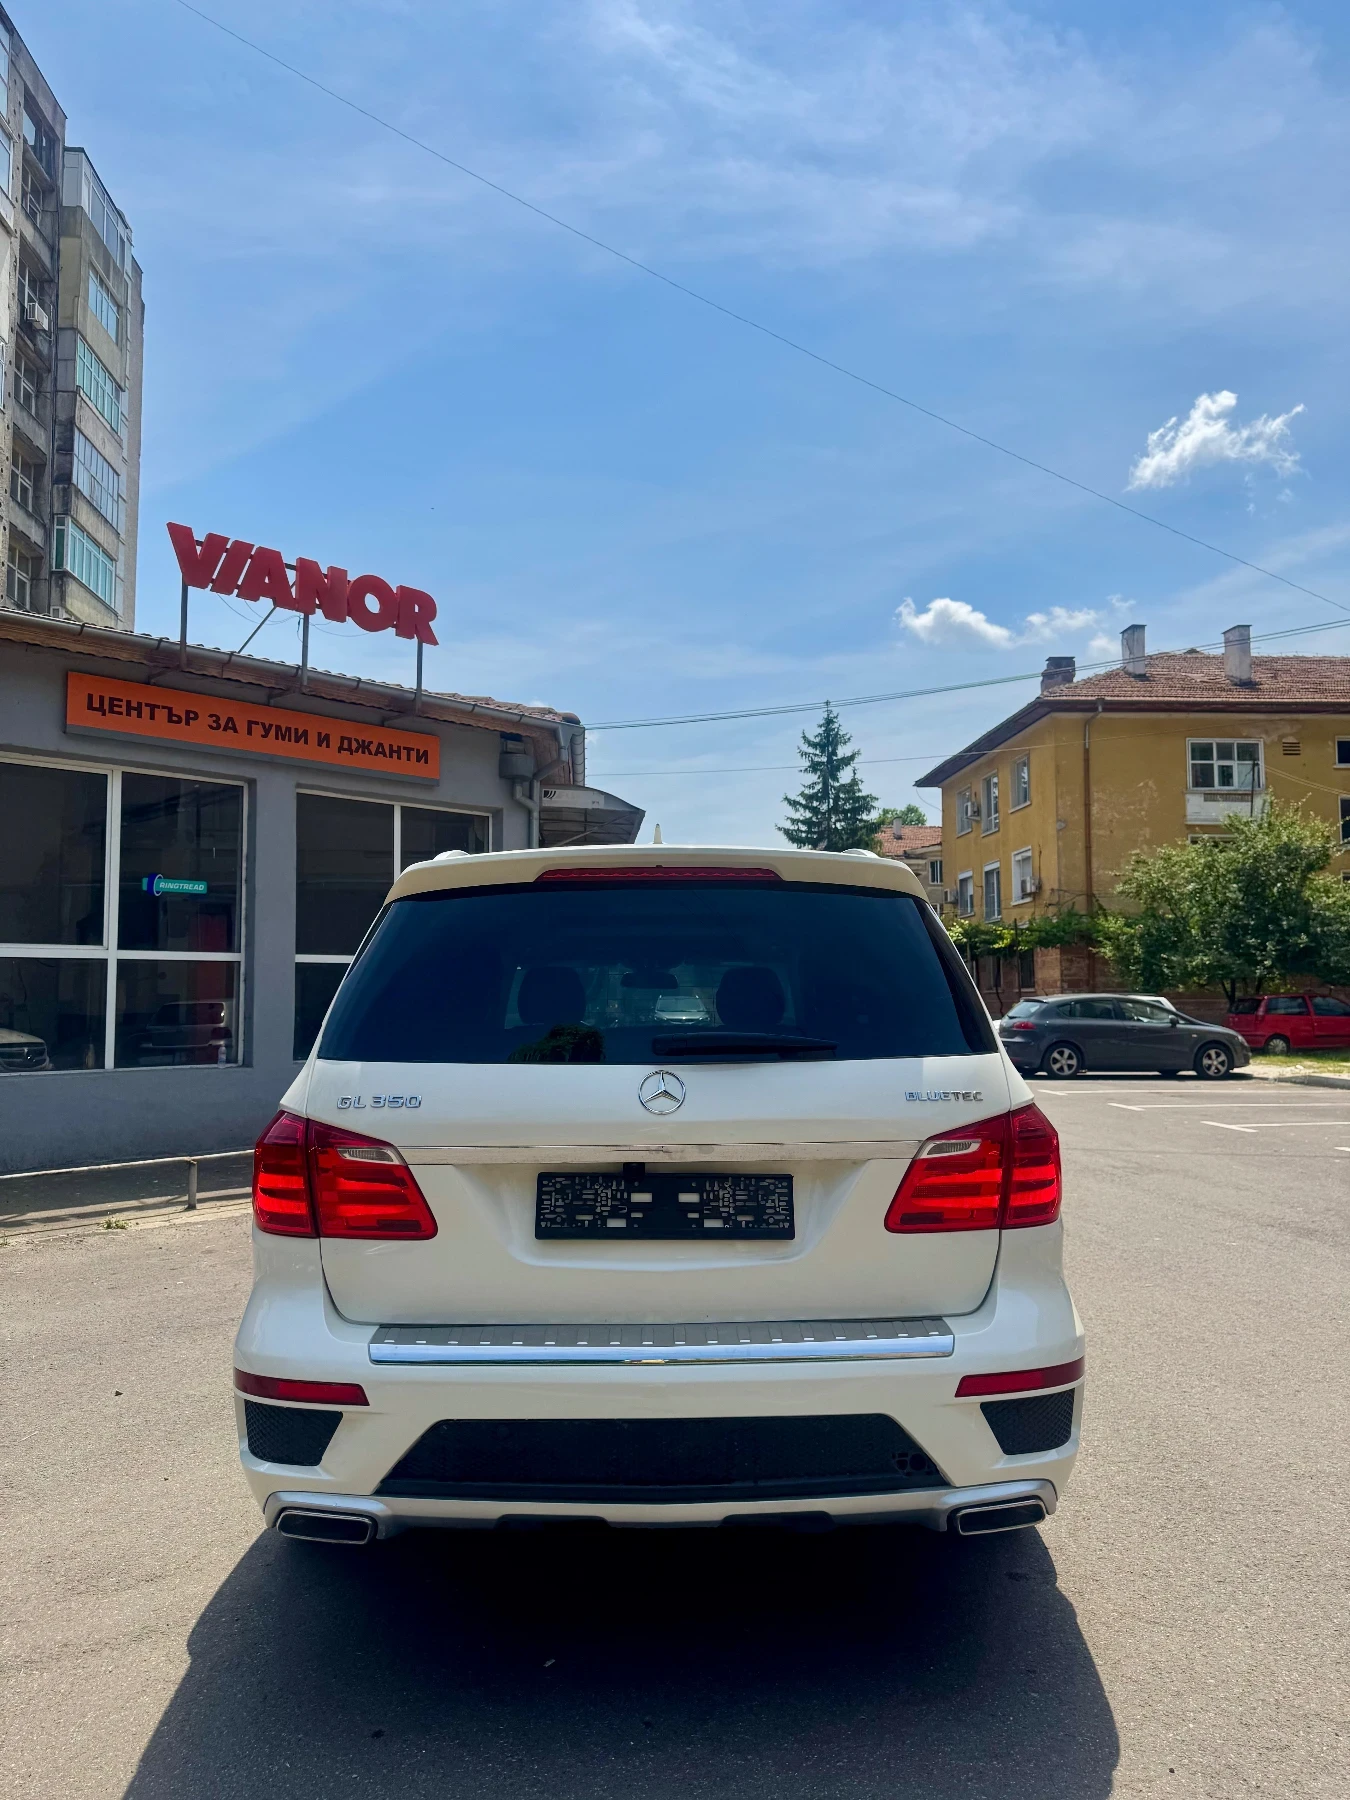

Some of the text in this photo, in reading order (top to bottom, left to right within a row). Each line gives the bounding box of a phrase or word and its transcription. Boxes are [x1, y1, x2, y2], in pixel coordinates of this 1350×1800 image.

[166, 521, 439, 646] VIANOR
[86, 692, 429, 765] ЦЕНТЪР ЗА ГУМИ И ДЖАНТИ
[159, 881, 205, 891] RINGTREAD
[336, 1094, 423, 1109] GL 350
[904, 1090, 984, 1102] BLUETEC
